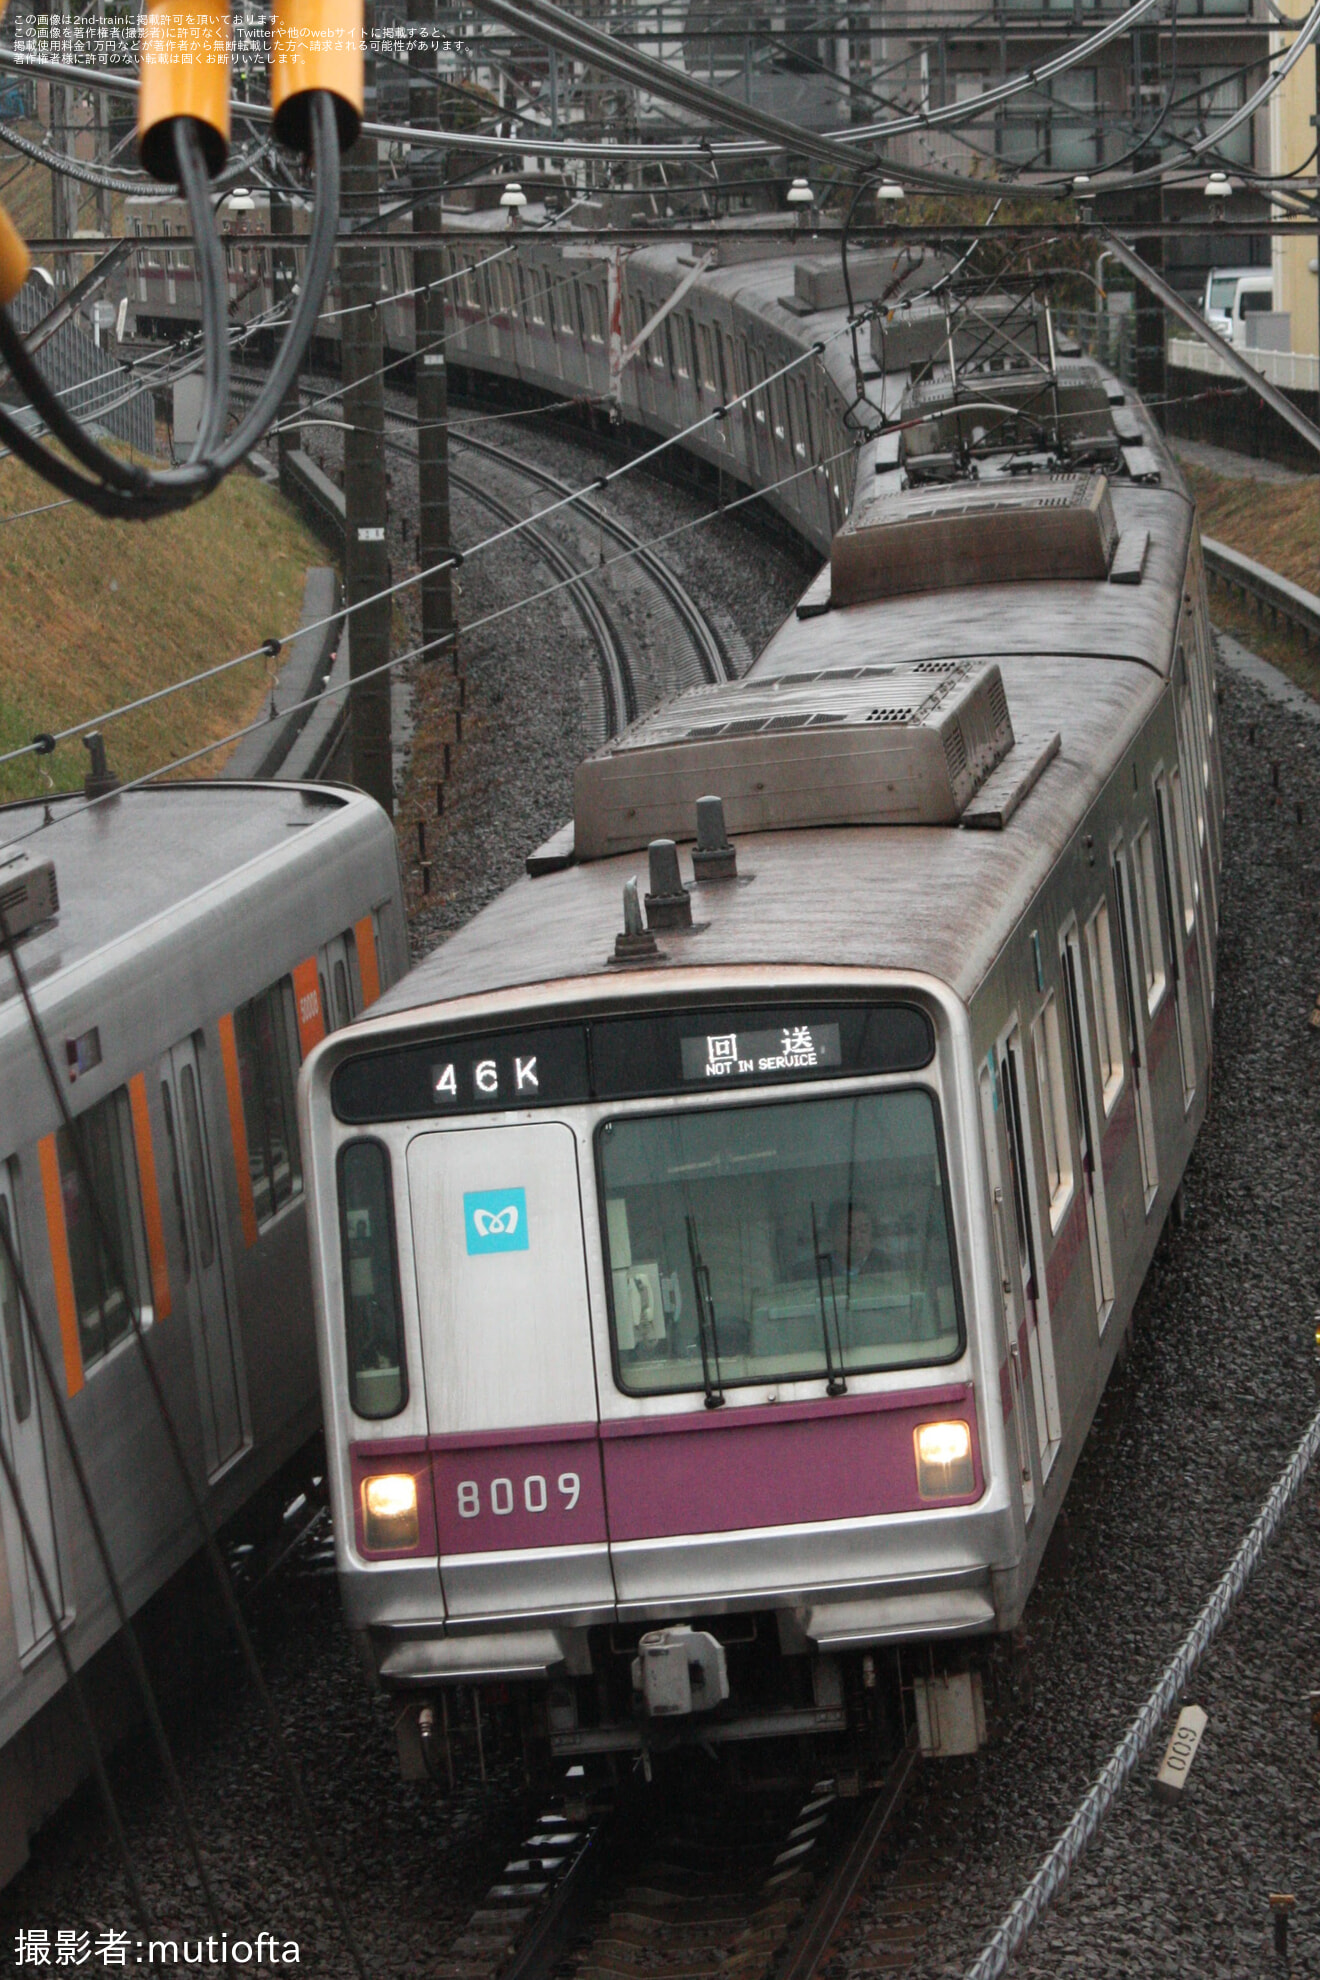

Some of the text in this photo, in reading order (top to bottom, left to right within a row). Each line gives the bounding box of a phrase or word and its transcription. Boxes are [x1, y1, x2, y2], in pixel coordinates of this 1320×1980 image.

[705, 1053, 818, 1077] NOT IN SERVICE
[457, 1472, 581, 1518] 8009
